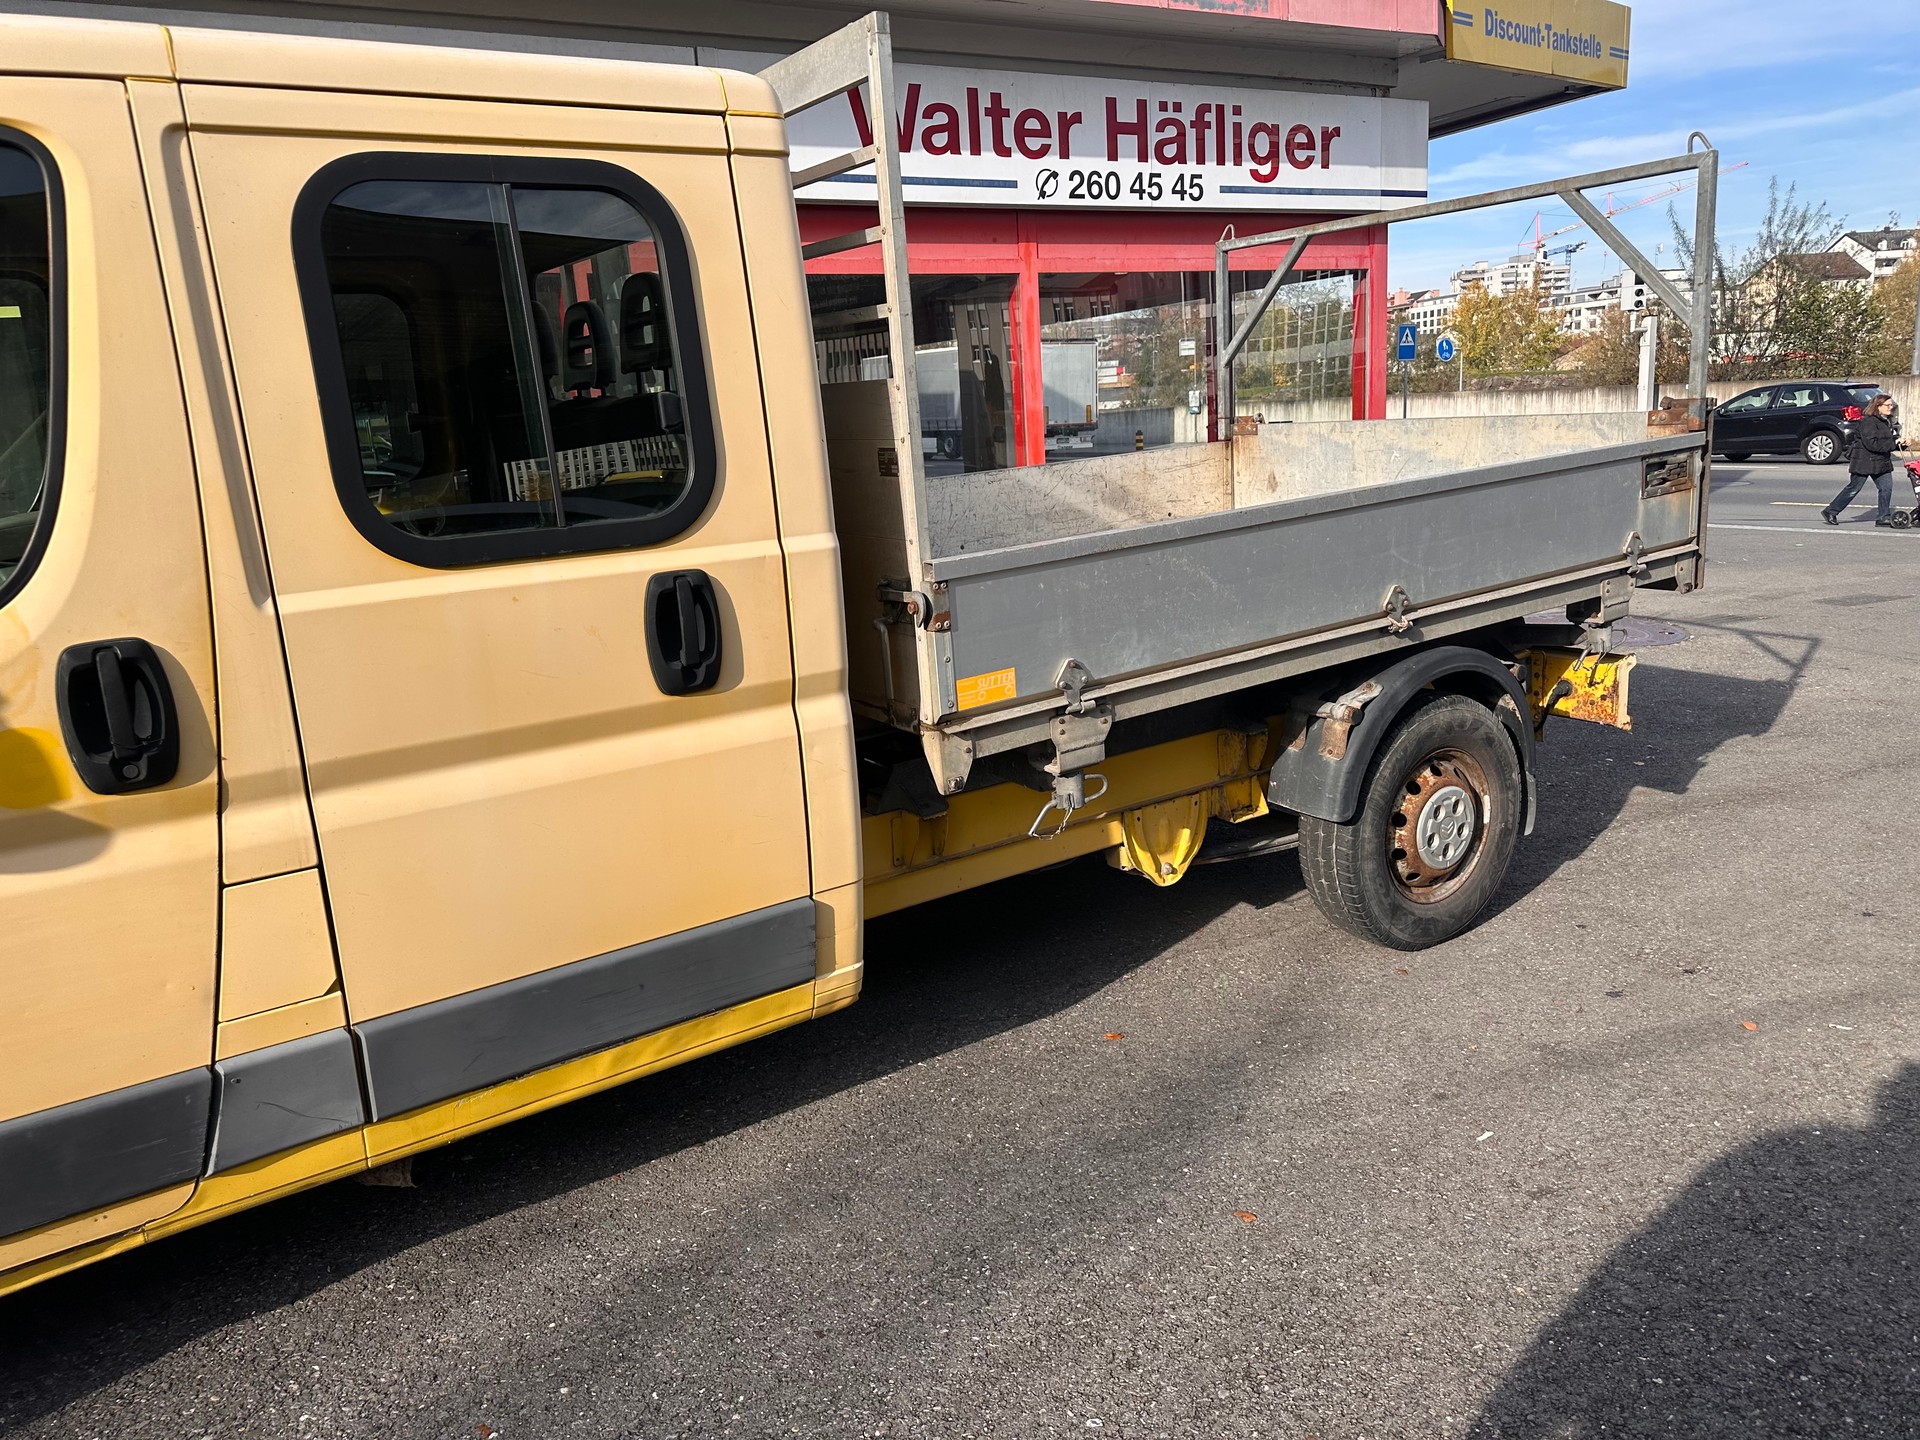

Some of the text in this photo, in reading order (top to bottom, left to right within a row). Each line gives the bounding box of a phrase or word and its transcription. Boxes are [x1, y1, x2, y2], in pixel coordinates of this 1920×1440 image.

[1484, 8, 1602, 59] Discount-Tankstelle
[1105, 96, 1341, 184] Häfliger
[1068, 169, 1204, 202] 260 45 45
[977, 671, 1015, 689] SUTTER
